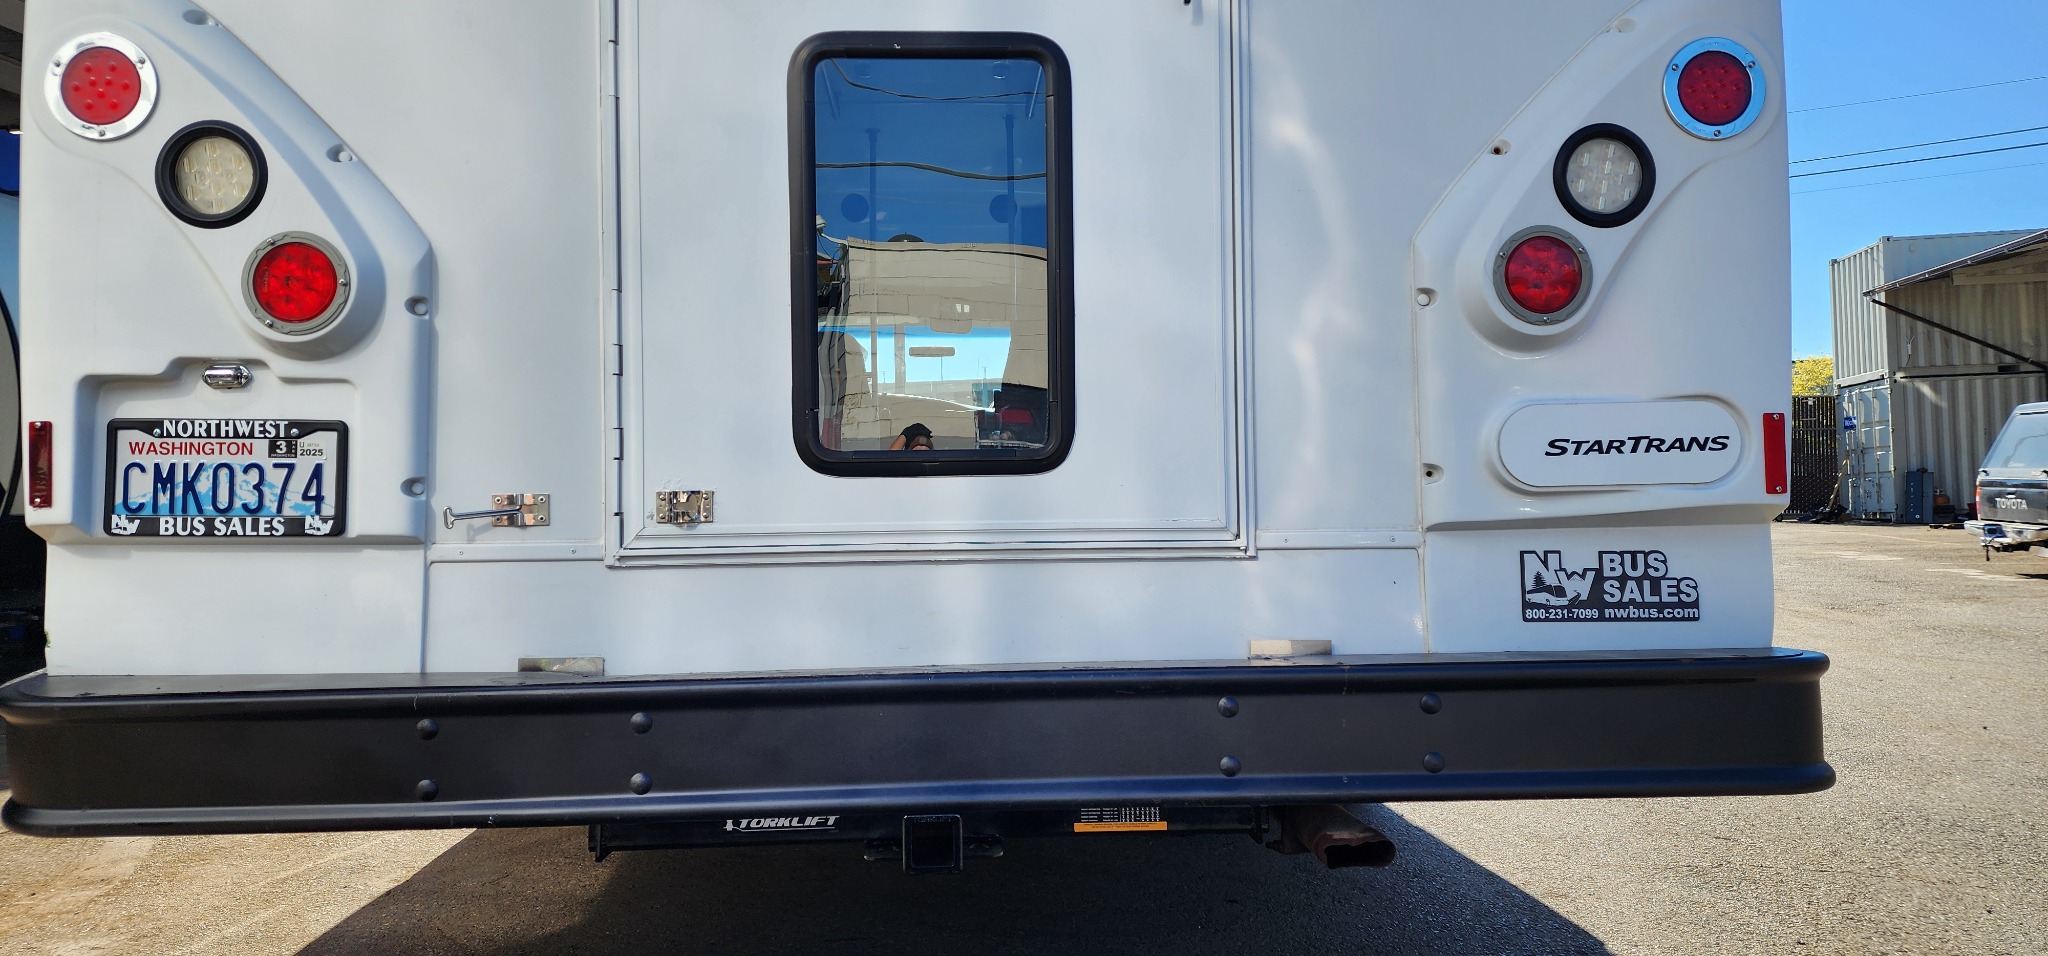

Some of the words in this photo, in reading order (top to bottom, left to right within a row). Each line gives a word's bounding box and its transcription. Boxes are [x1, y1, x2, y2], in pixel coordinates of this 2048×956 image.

[163, 419, 288, 438] NORTHWEST
[129, 441, 253, 456] WASHINGTON
[275, 440, 287, 454] 3
[122, 462, 325, 515] CMK0374
[1995, 498, 2028, 510] TOYOTA
[159, 517, 206, 536] BUS
[213, 517, 285, 536] SALES
[1602, 553, 1667, 577] BUS
[1603, 579, 1698, 602] SALES
[1525, 609, 1599, 619] 800-231-7099
[1604, 606, 1699, 618] nwbus.com
[739, 816, 840, 829] TORKLIFT
